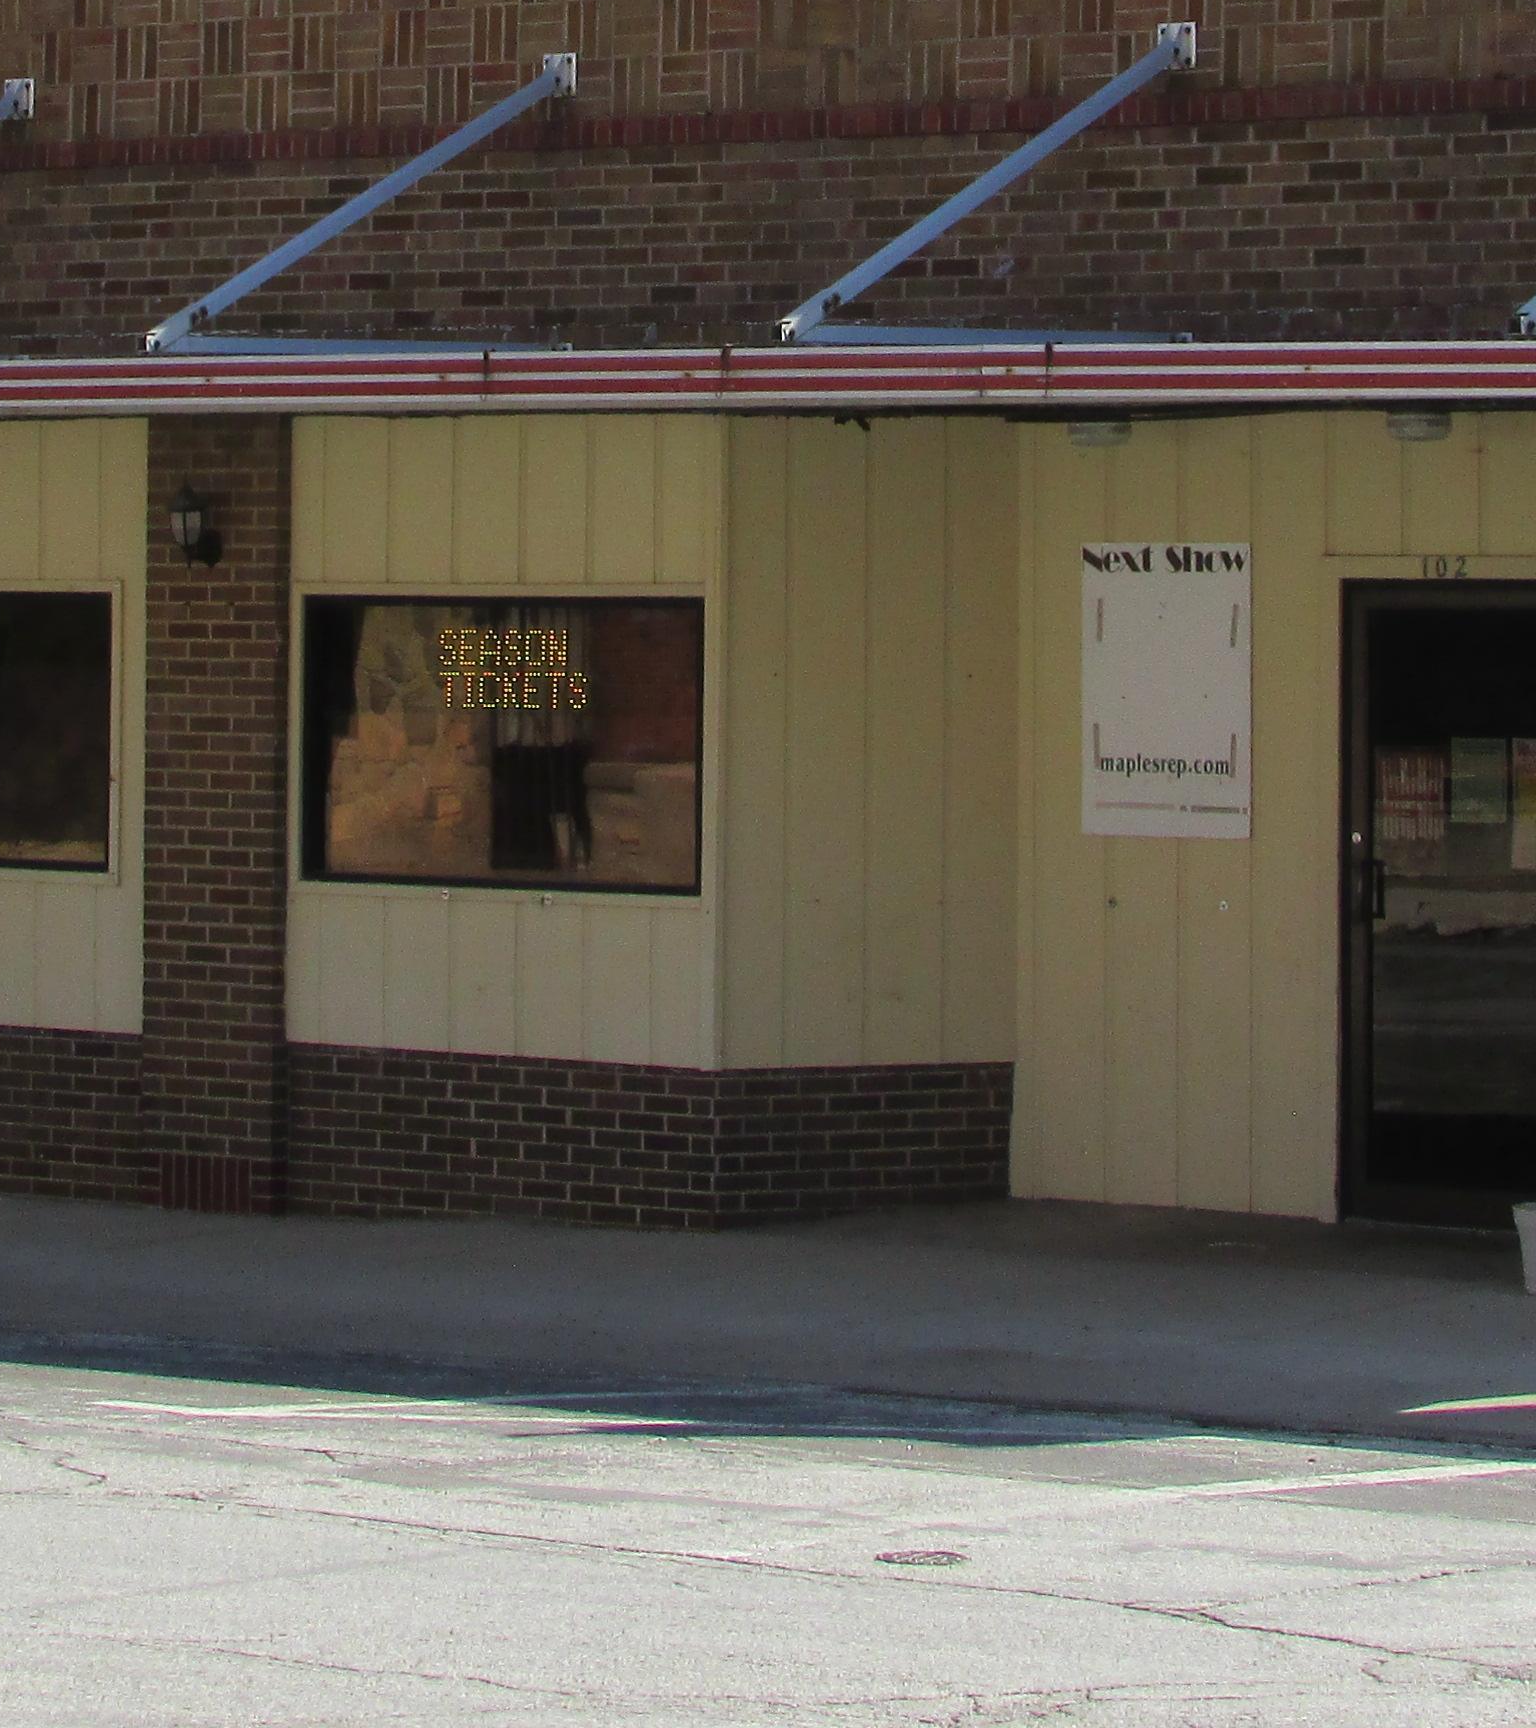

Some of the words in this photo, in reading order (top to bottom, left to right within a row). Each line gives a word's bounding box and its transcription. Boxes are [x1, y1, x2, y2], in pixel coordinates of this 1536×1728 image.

[1083, 546, 1153, 573] Next
[1166, 545, 1248, 573] Show
[1421, 556, 1468, 577] 102
[439, 629, 568, 667] SEASON
[439, 671, 589, 710] TICKETS
[1101, 754, 1230, 777] maplesrep.com
